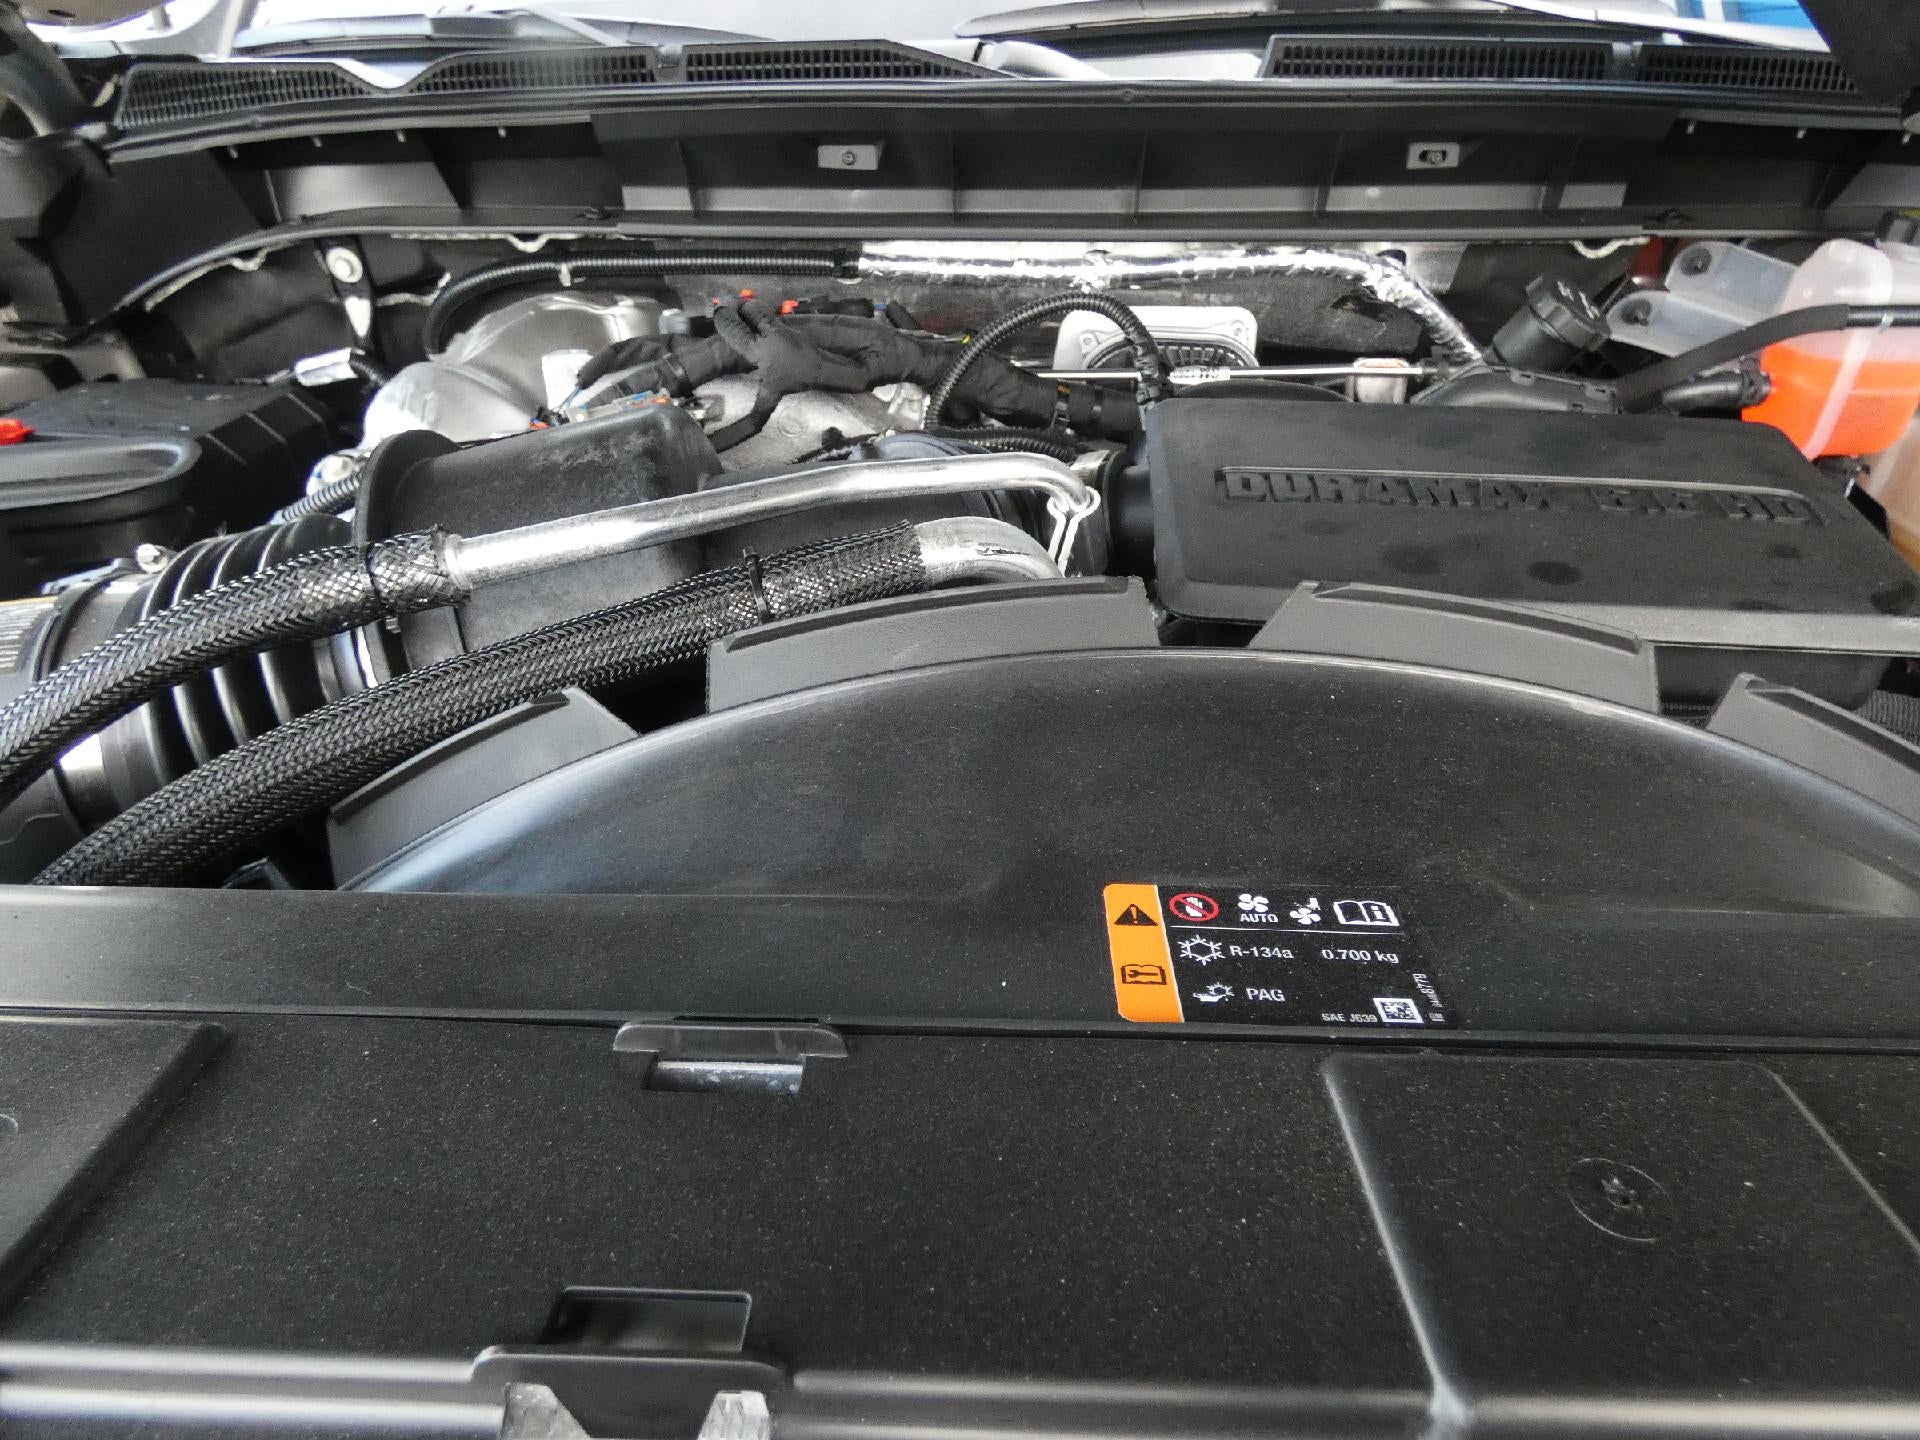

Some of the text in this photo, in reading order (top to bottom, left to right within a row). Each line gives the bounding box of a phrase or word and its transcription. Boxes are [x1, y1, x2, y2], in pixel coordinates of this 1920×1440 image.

[1224, 471, 1554, 511] DURAMAX
[1240, 913, 1279, 924] AUTO
[1229, 945, 1399, 964] R-134a 0.700 kg
[1245, 988, 1287, 1002] PAG
[1321, 1013, 1378, 1023] SAE J639
